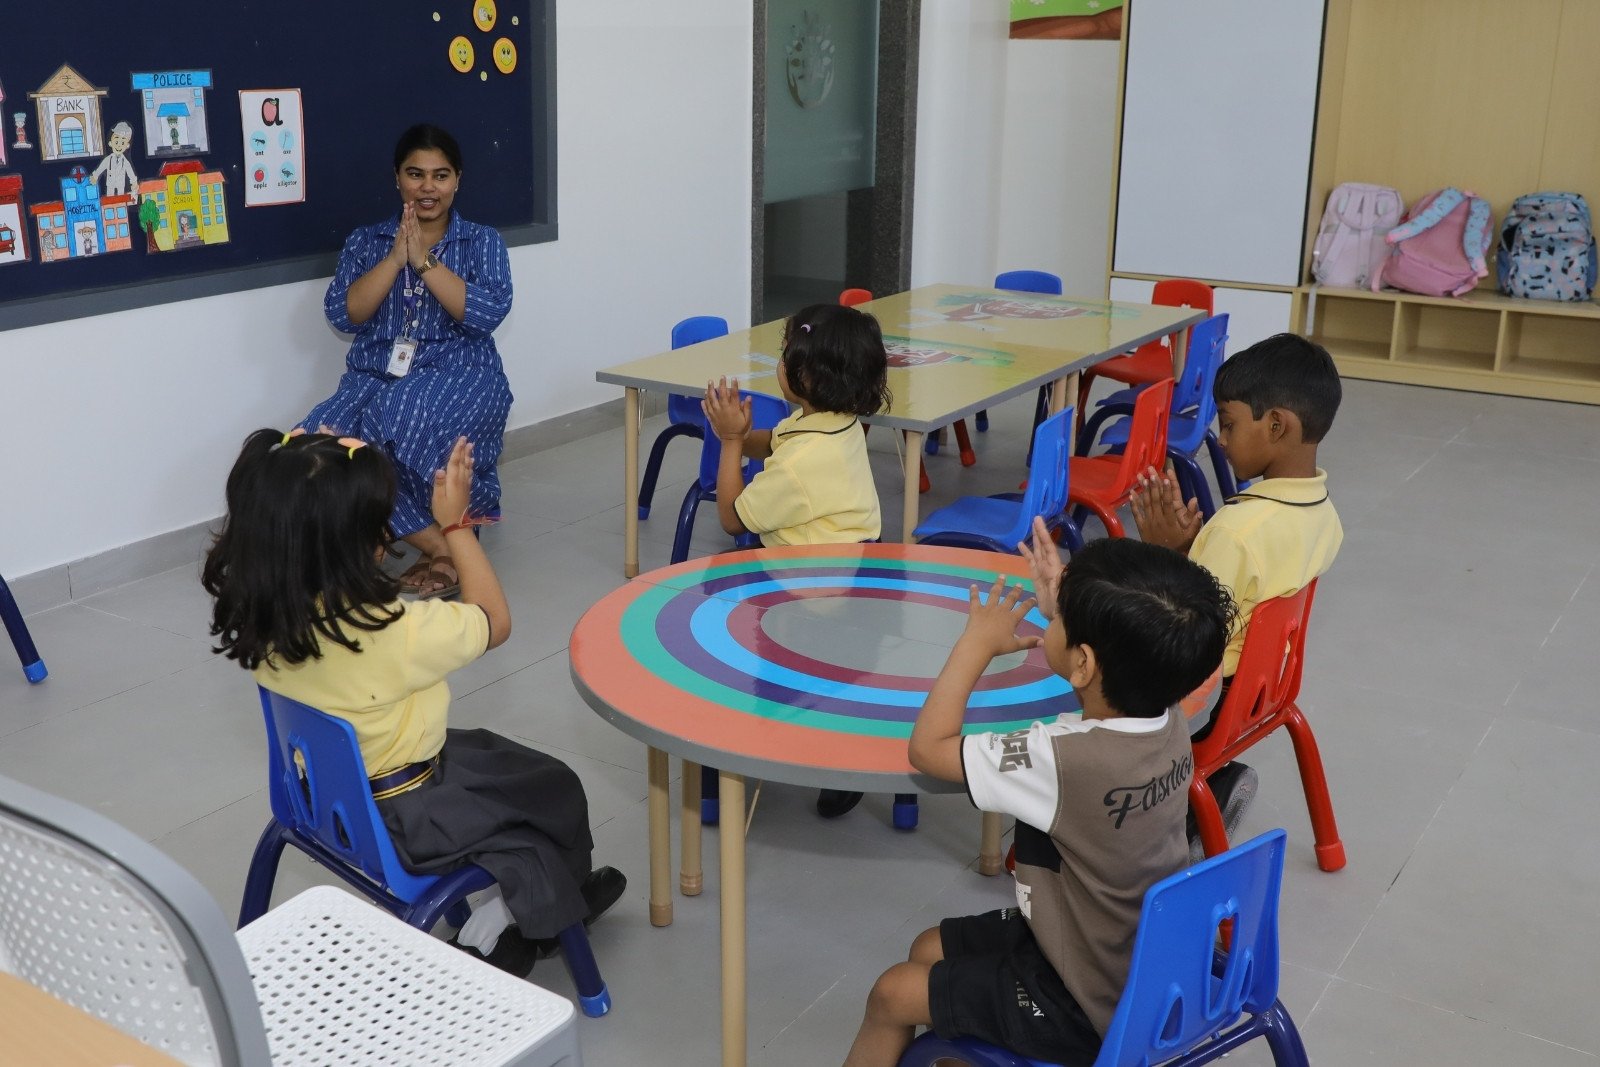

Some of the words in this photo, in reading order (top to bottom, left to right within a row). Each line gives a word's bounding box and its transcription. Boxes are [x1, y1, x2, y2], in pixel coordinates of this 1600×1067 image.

[153, 73, 192, 87] POLICE
[56, 98, 84, 112] BANK
[261, 98, 283, 126] a
[253, 182, 267, 190] apple
[277, 180, 297, 188] alligator
[173, 196, 194, 205] SCHOOL
[67, 204, 98, 215] HOSPITAL
